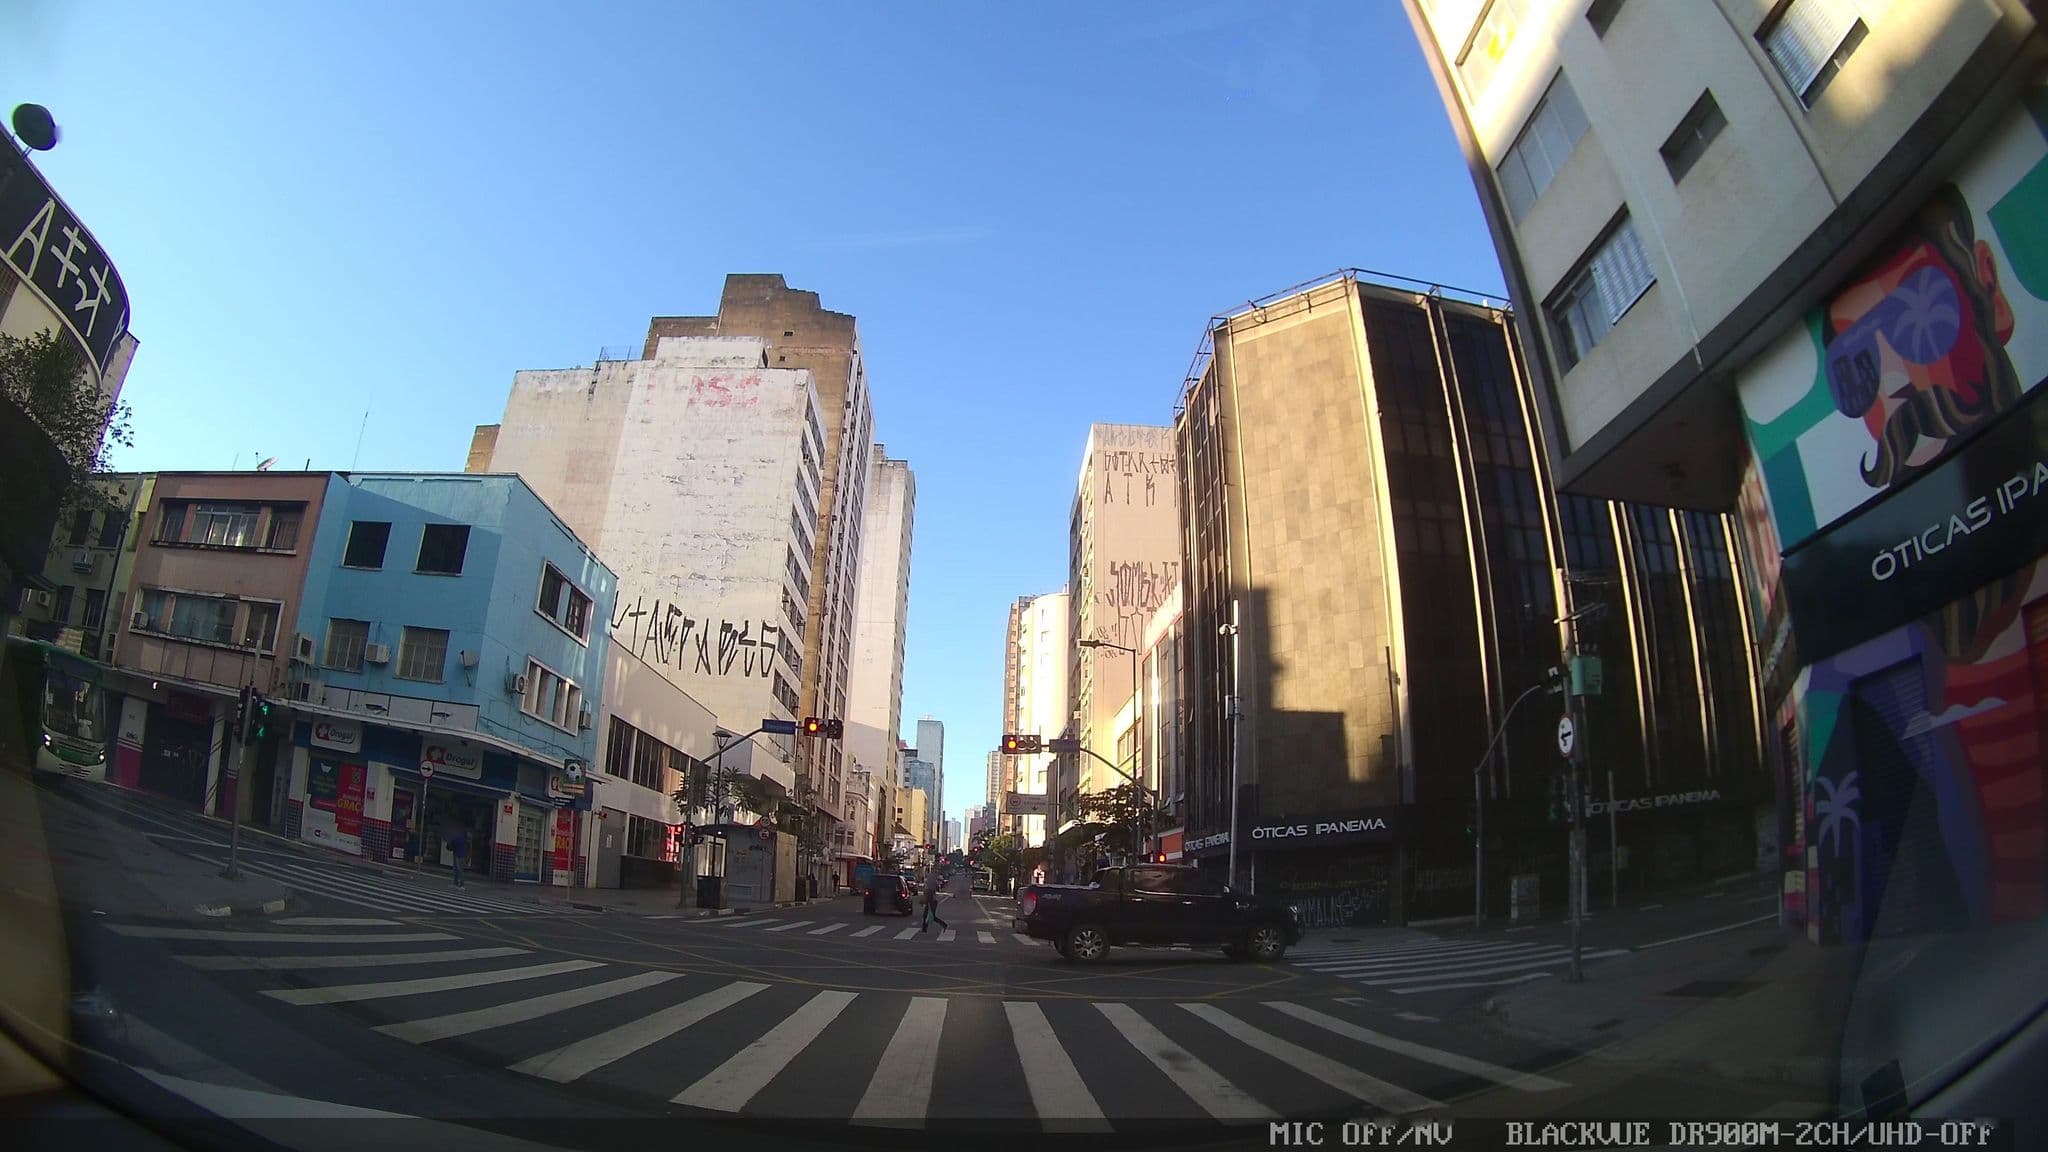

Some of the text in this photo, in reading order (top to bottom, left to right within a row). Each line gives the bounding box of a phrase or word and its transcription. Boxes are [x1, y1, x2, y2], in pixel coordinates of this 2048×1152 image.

[1871, 495, 1992, 581] ÓTICAS
[445, 753, 476, 768] Drogal
[1654, 789, 1721, 808] IPANEMA
[1251, 817, 1386, 839] ÓTICAS IPANEMA
